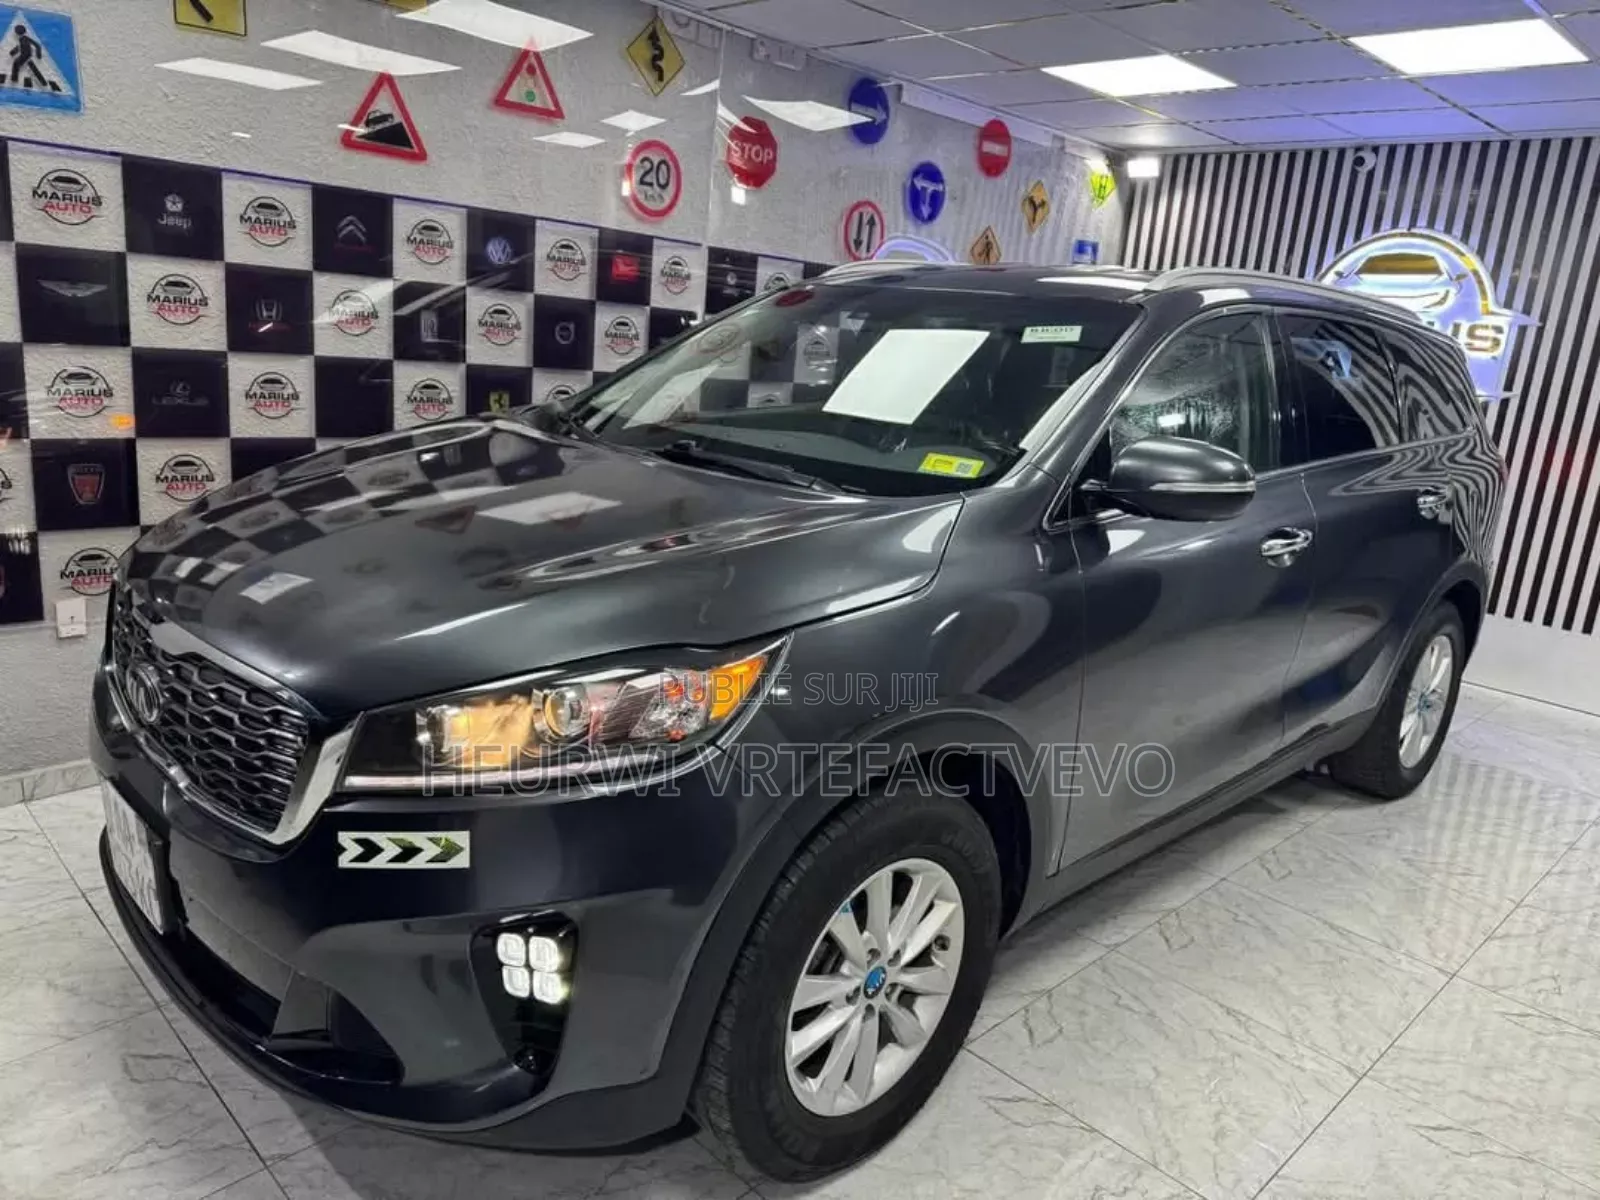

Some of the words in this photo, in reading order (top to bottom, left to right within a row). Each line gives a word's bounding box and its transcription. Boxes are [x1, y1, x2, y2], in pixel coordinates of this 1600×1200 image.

[730, 140, 774, 164] STOP
[639, 156, 671, 190] 20
[32, 189, 103, 208] MARIUS
[43, 202, 93, 215] AUTO
[158, 213, 192, 230] Jeep
[240, 214, 297, 229] MARIUS
[248, 225, 288, 237] AUTO
[414, 246, 447, 257] AUTO
[147, 294, 208, 308] MARIUS
[156, 304, 200, 315] AUTO
[47, 387, 114, 398] MARIUS
[245, 391, 300, 401] MARIUS
[59, 397, 104, 407] AUTO
[253, 399, 293, 409] AUTO
[413, 403, 446, 413] AUTO
[155, 474, 215, 485] MARIUS
[165, 482, 207, 492] AUTO
[60, 566, 118, 580] MARIU
